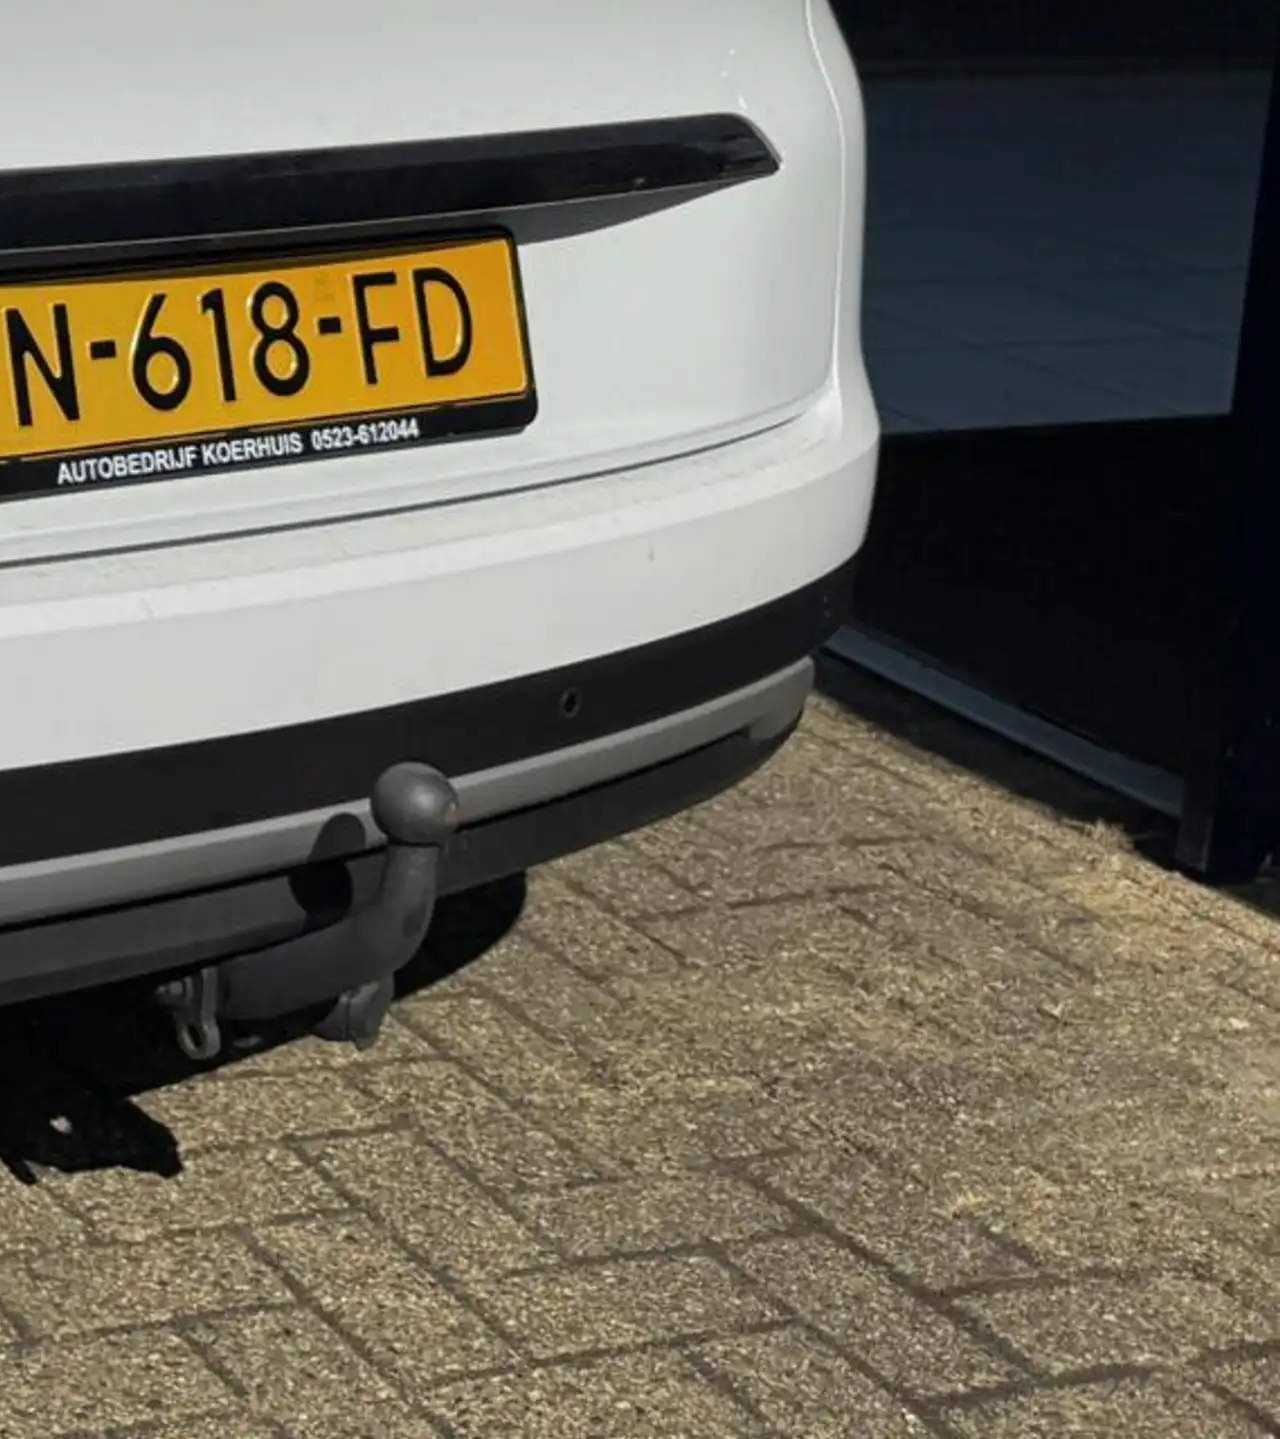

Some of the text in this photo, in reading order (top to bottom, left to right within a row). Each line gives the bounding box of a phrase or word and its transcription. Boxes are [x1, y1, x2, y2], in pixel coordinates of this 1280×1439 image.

[3, 266, 473, 427] N-618-FD
[57, 417, 420, 485] AUTOBEDRIJF KOERHUIS 0523-612044
